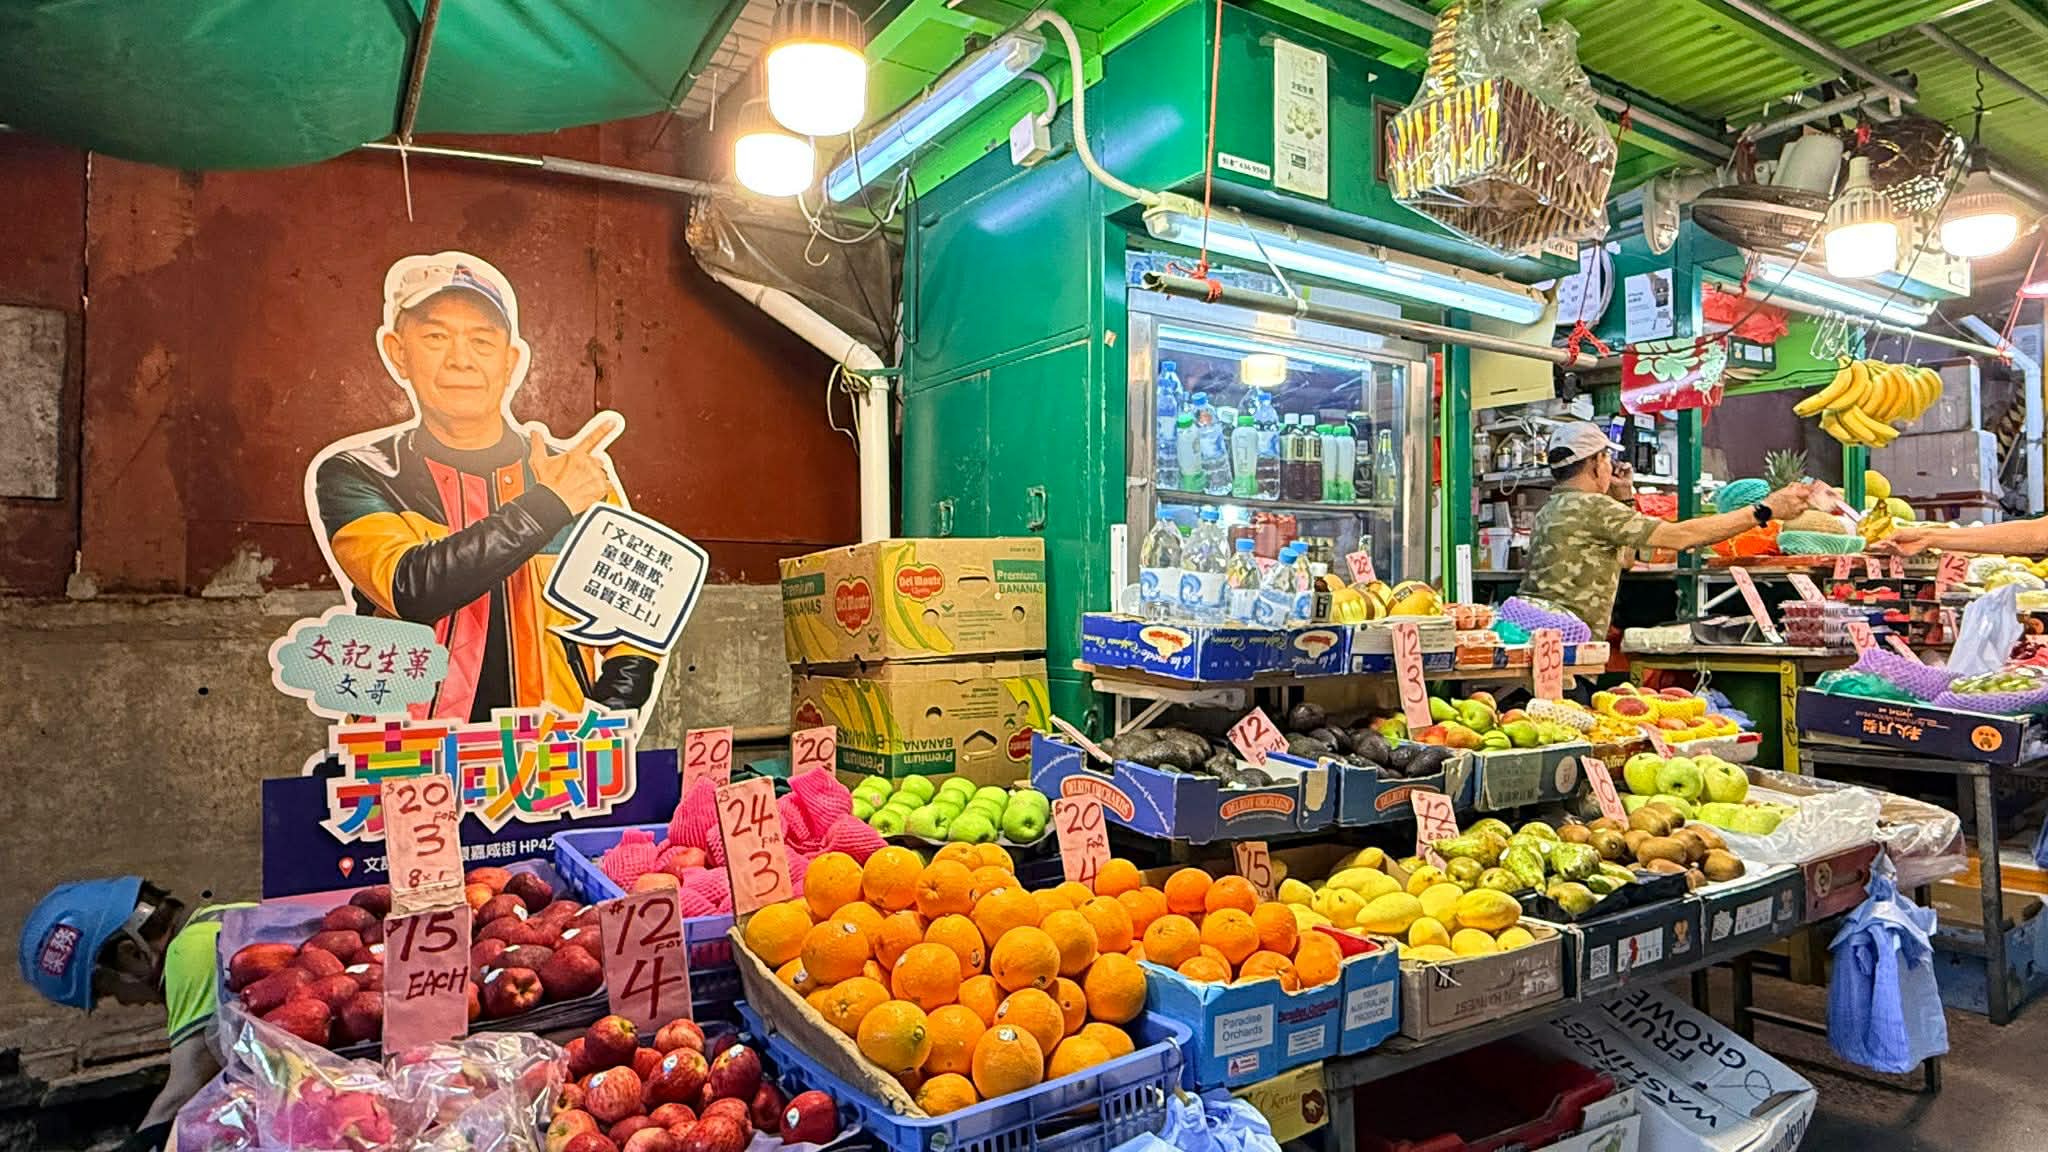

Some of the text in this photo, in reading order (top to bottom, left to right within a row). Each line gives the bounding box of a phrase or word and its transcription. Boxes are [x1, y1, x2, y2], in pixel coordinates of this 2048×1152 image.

[304, 634, 432, 680] 文記生菓
[335, 673, 391, 706] 文哥
[1406, 664, 1424, 703] 3
[412, 823, 446, 857] 3
[749, 850, 780, 898] 3
[1078, 855, 1098, 890] 4
[405, 965, 469, 1000] EACH
[620, 955, 682, 1020] 4
[1222, 1013, 1263, 1030] Paradise
[1222, 1023, 1264, 1042] Orchards
[1600, 1000, 1695, 1063] FRUIT
[1625, 989, 1747, 1069] GROWE
